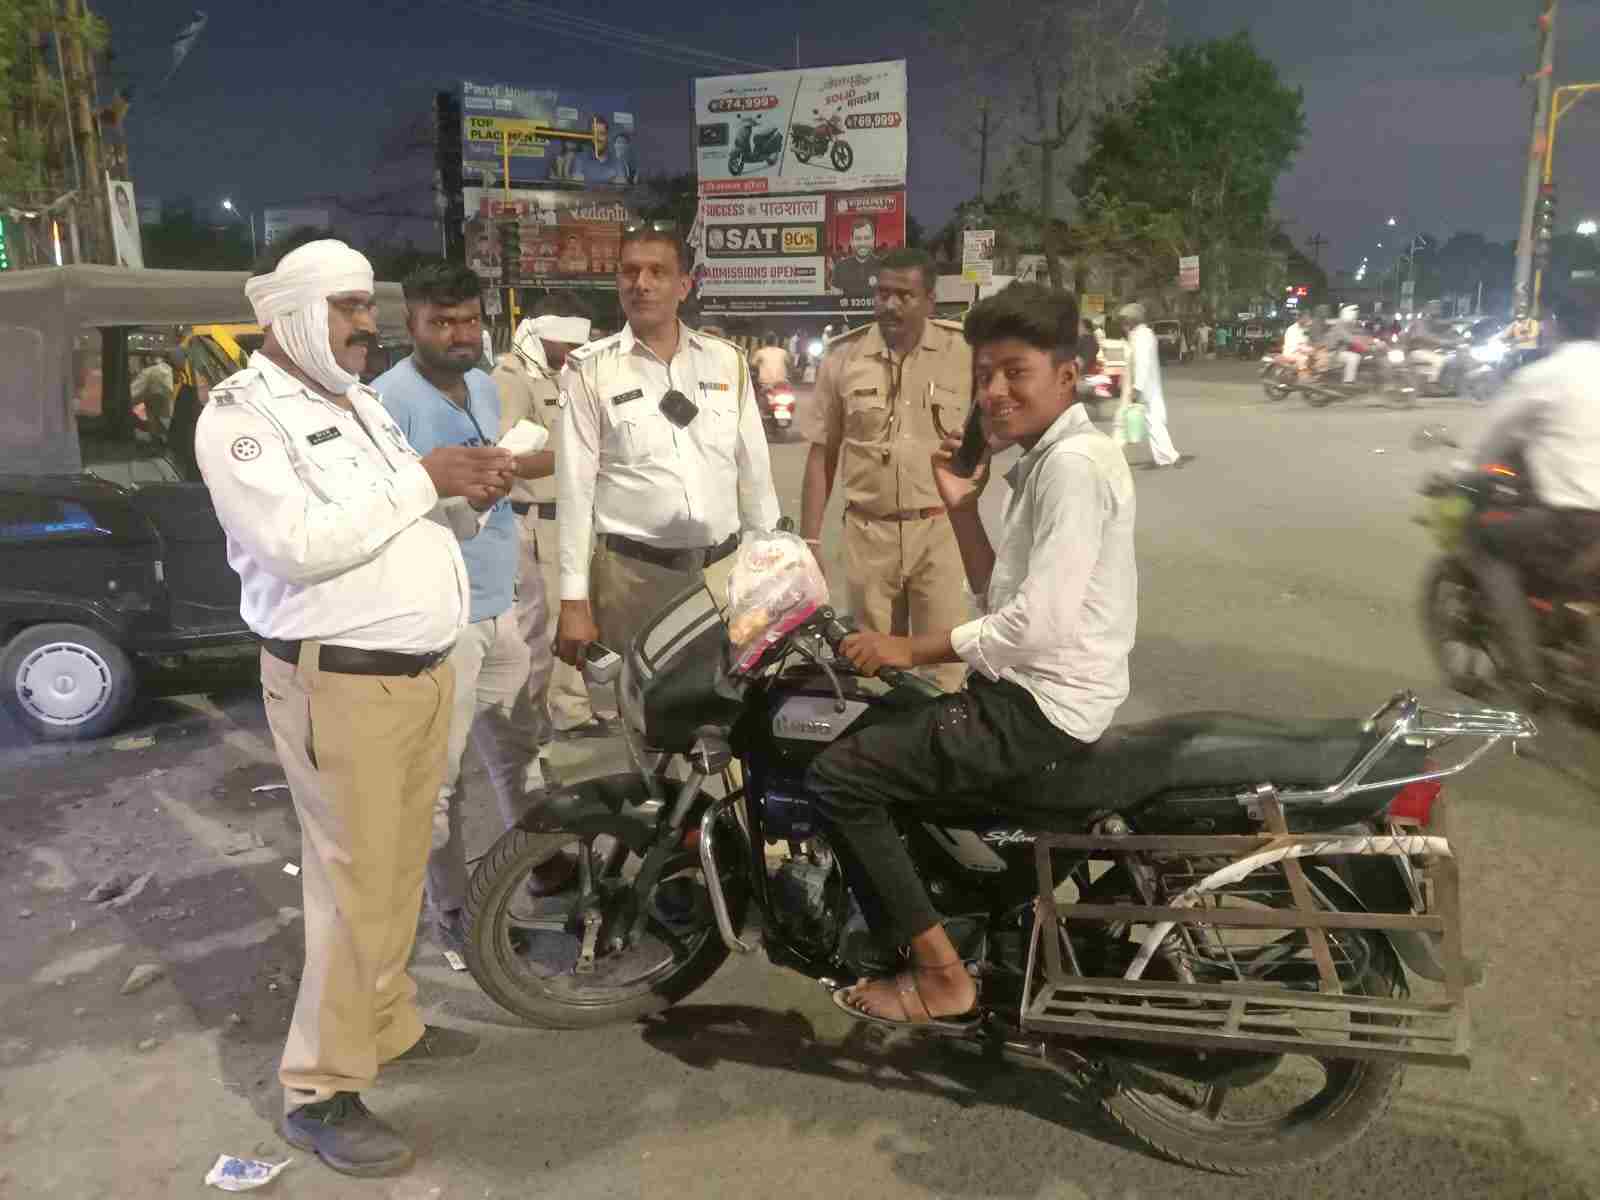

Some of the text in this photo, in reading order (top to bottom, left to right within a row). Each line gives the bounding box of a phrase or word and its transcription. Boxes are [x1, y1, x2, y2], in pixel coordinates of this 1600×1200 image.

[470, 118, 494, 127] TOP
[470, 130, 550, 143] PLACMENTS
[702, 204, 745, 217] SUCCESS
[759, 200, 818, 217] पाठशाला
[783, 232, 815, 246] 90%
[703, 266, 768, 279] ADMISSIONS
[770, 266, 798, 278] OPEN
